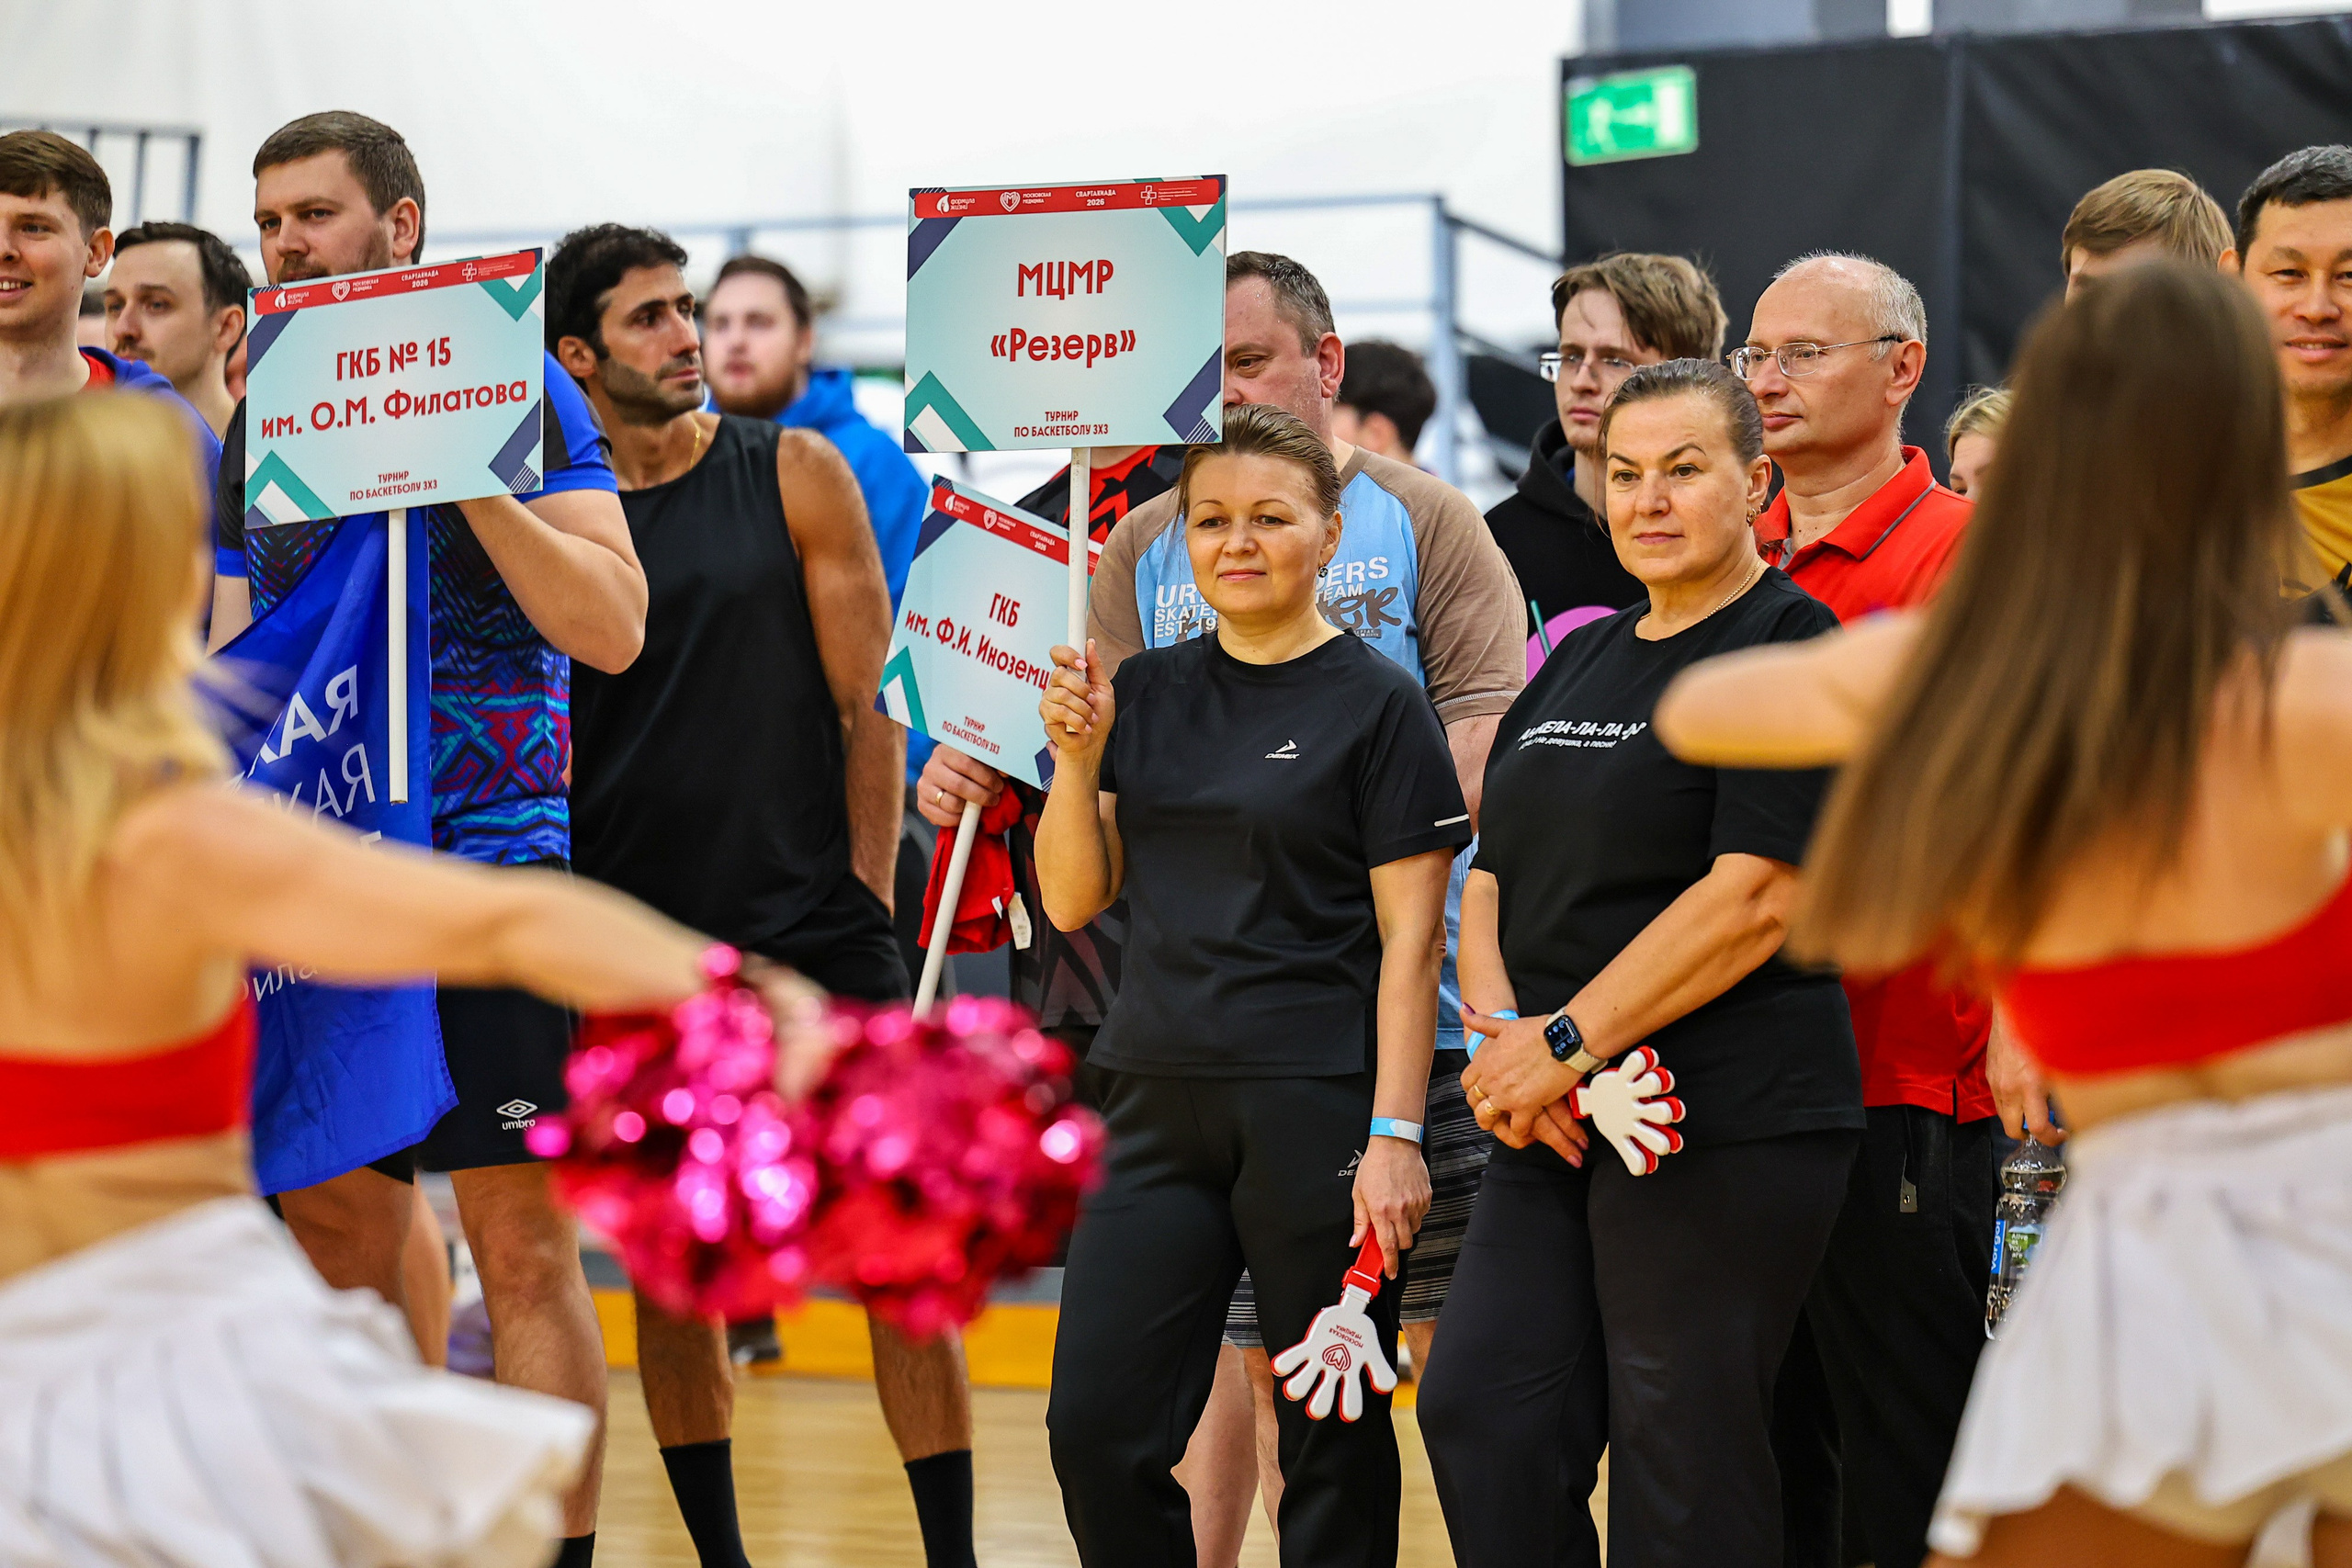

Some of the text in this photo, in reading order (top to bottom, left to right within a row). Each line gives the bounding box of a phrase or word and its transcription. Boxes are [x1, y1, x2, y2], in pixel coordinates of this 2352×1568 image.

[1075, 189, 1116, 198] СПАРТАКИАДА
[1086, 198, 1105, 207] 2026
[401, 269, 439, 282] СПАРТАКИАДА
[412, 279, 429, 288] 2026
[1017, 259, 1114, 300] МЦМР
[989, 327, 1136, 368] «Резерв»
[336, 336, 452, 381] ГКБ № 15
[261, 380, 527, 440] им. О.М. Филатова
[1045, 410, 1079, 422] ТУРНИР
[1013, 426, 1029, 437] ПО
[1031, 423, 1091, 437] БАСКЕТБОЛУ
[378, 470, 410, 484] ТУРНИР
[350, 490, 364, 501] ПО
[366, 481, 421, 500] БАСКЕТБОЛУ
[1315, 582, 1363, 604] TEAM
[989, 592, 1021, 627] ГКБ
[1155, 619, 1188, 638] EST.
[1196, 615, 1219, 632] 19
[904, 609, 1050, 691] им. Ф.И. Иноземц
[964, 716, 986, 733] ТУРНИР
[942, 720, 953, 733] ПО
[952, 725, 990, 750] БАСКЕТБОЛУ
[502, 1119, 536, 1130] umbro
[1329, 1327, 1364, 1348] МОСКОВСКАЯ
